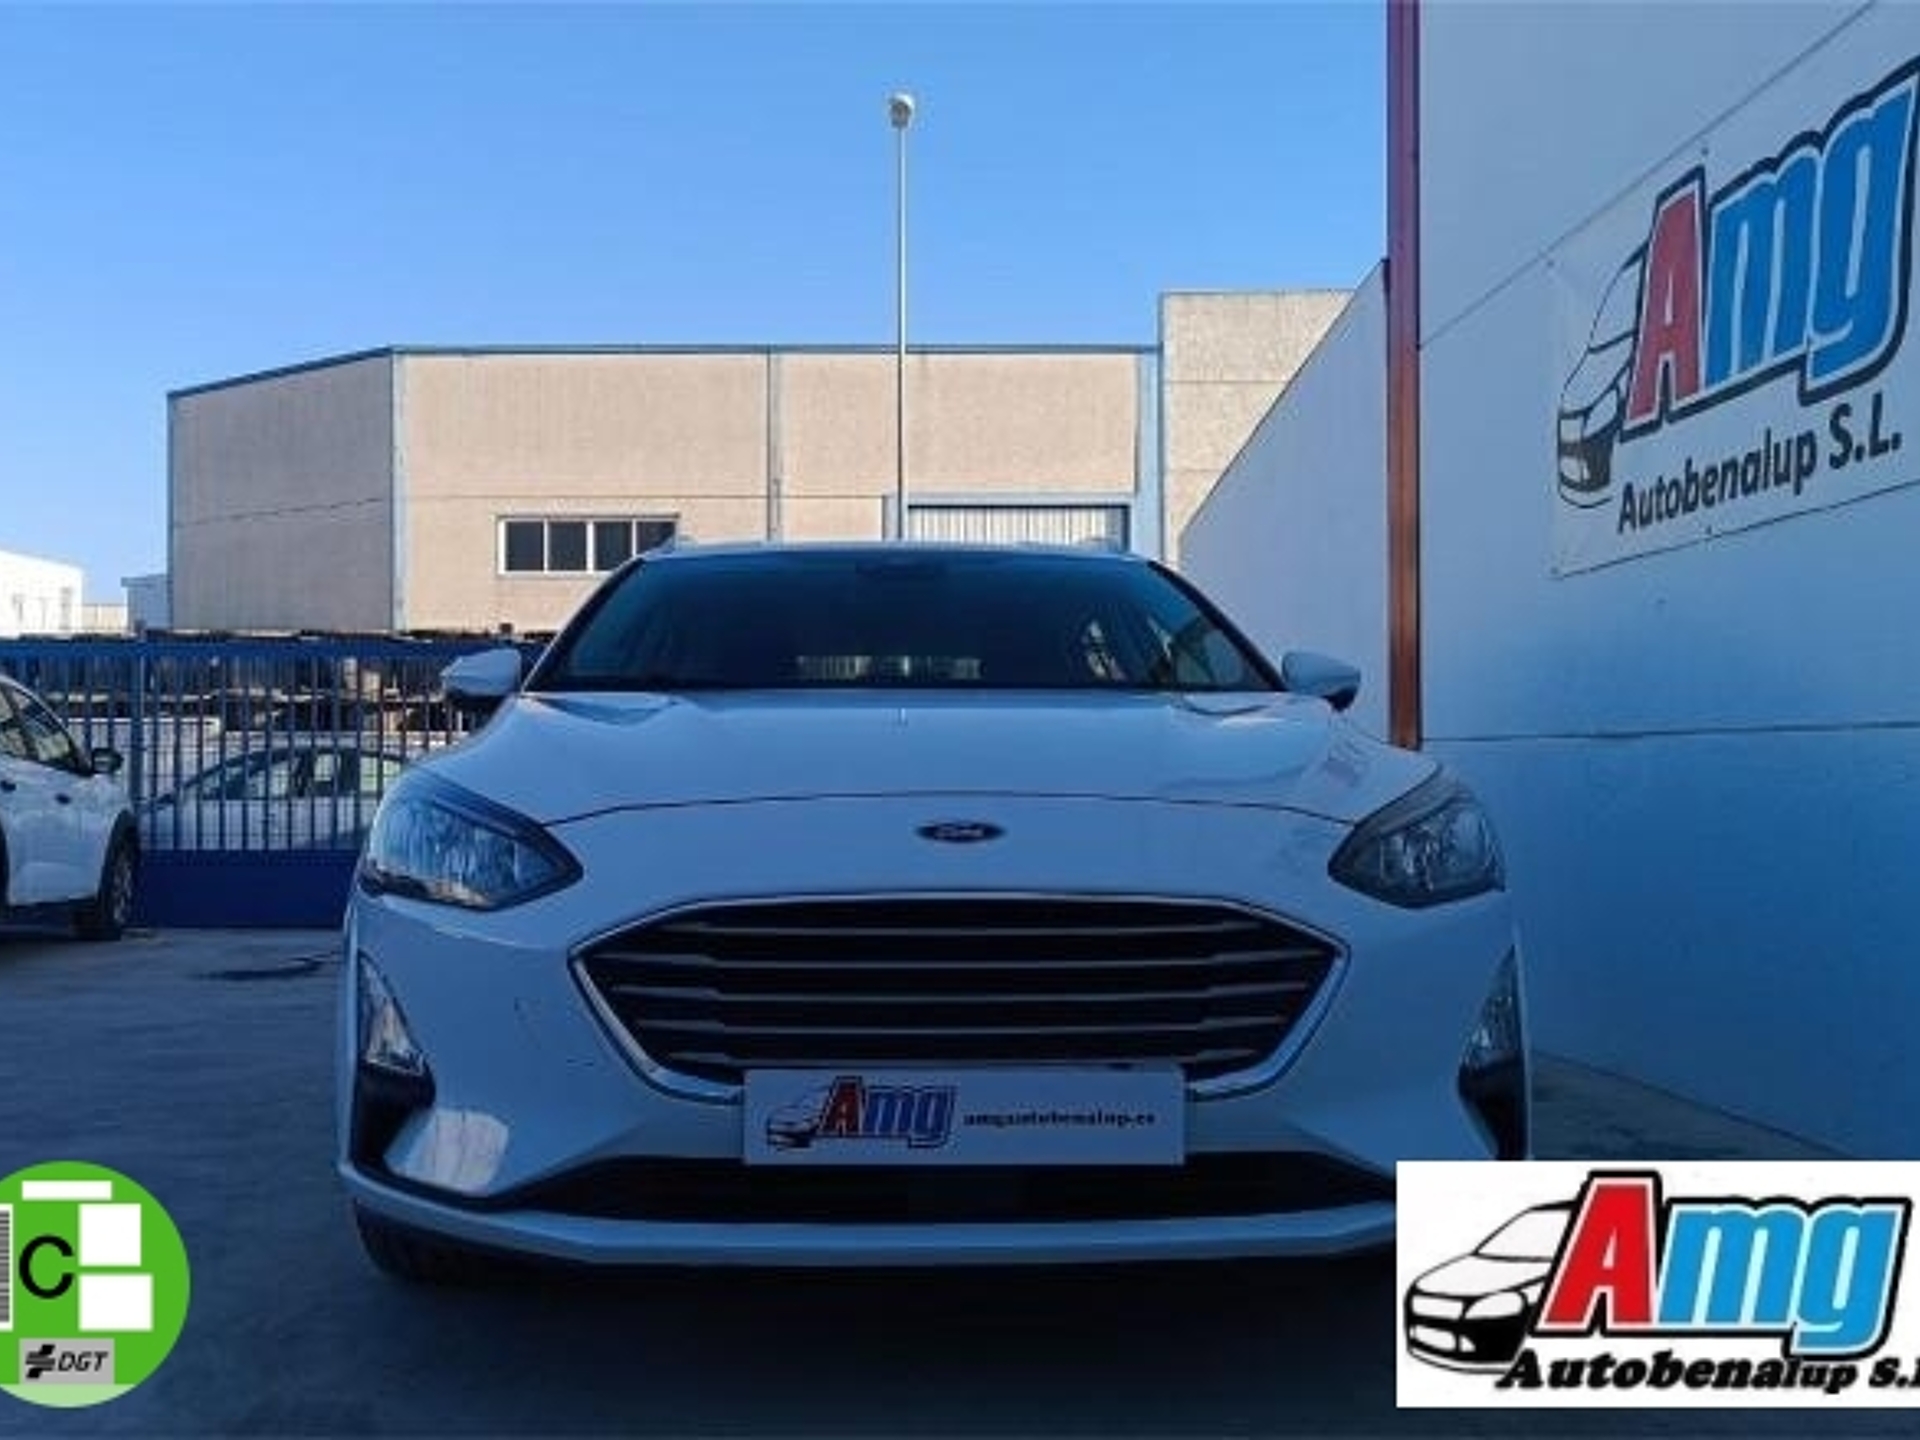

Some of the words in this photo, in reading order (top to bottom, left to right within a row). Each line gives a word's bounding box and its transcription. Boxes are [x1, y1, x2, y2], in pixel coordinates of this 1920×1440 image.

[1619, 57, 1920, 441] Amg
[1617, 428, 1818, 534] Autobenalup
[1829, 393, 1903, 470] S.L.
[820, 1075, 957, 1148] Amg
